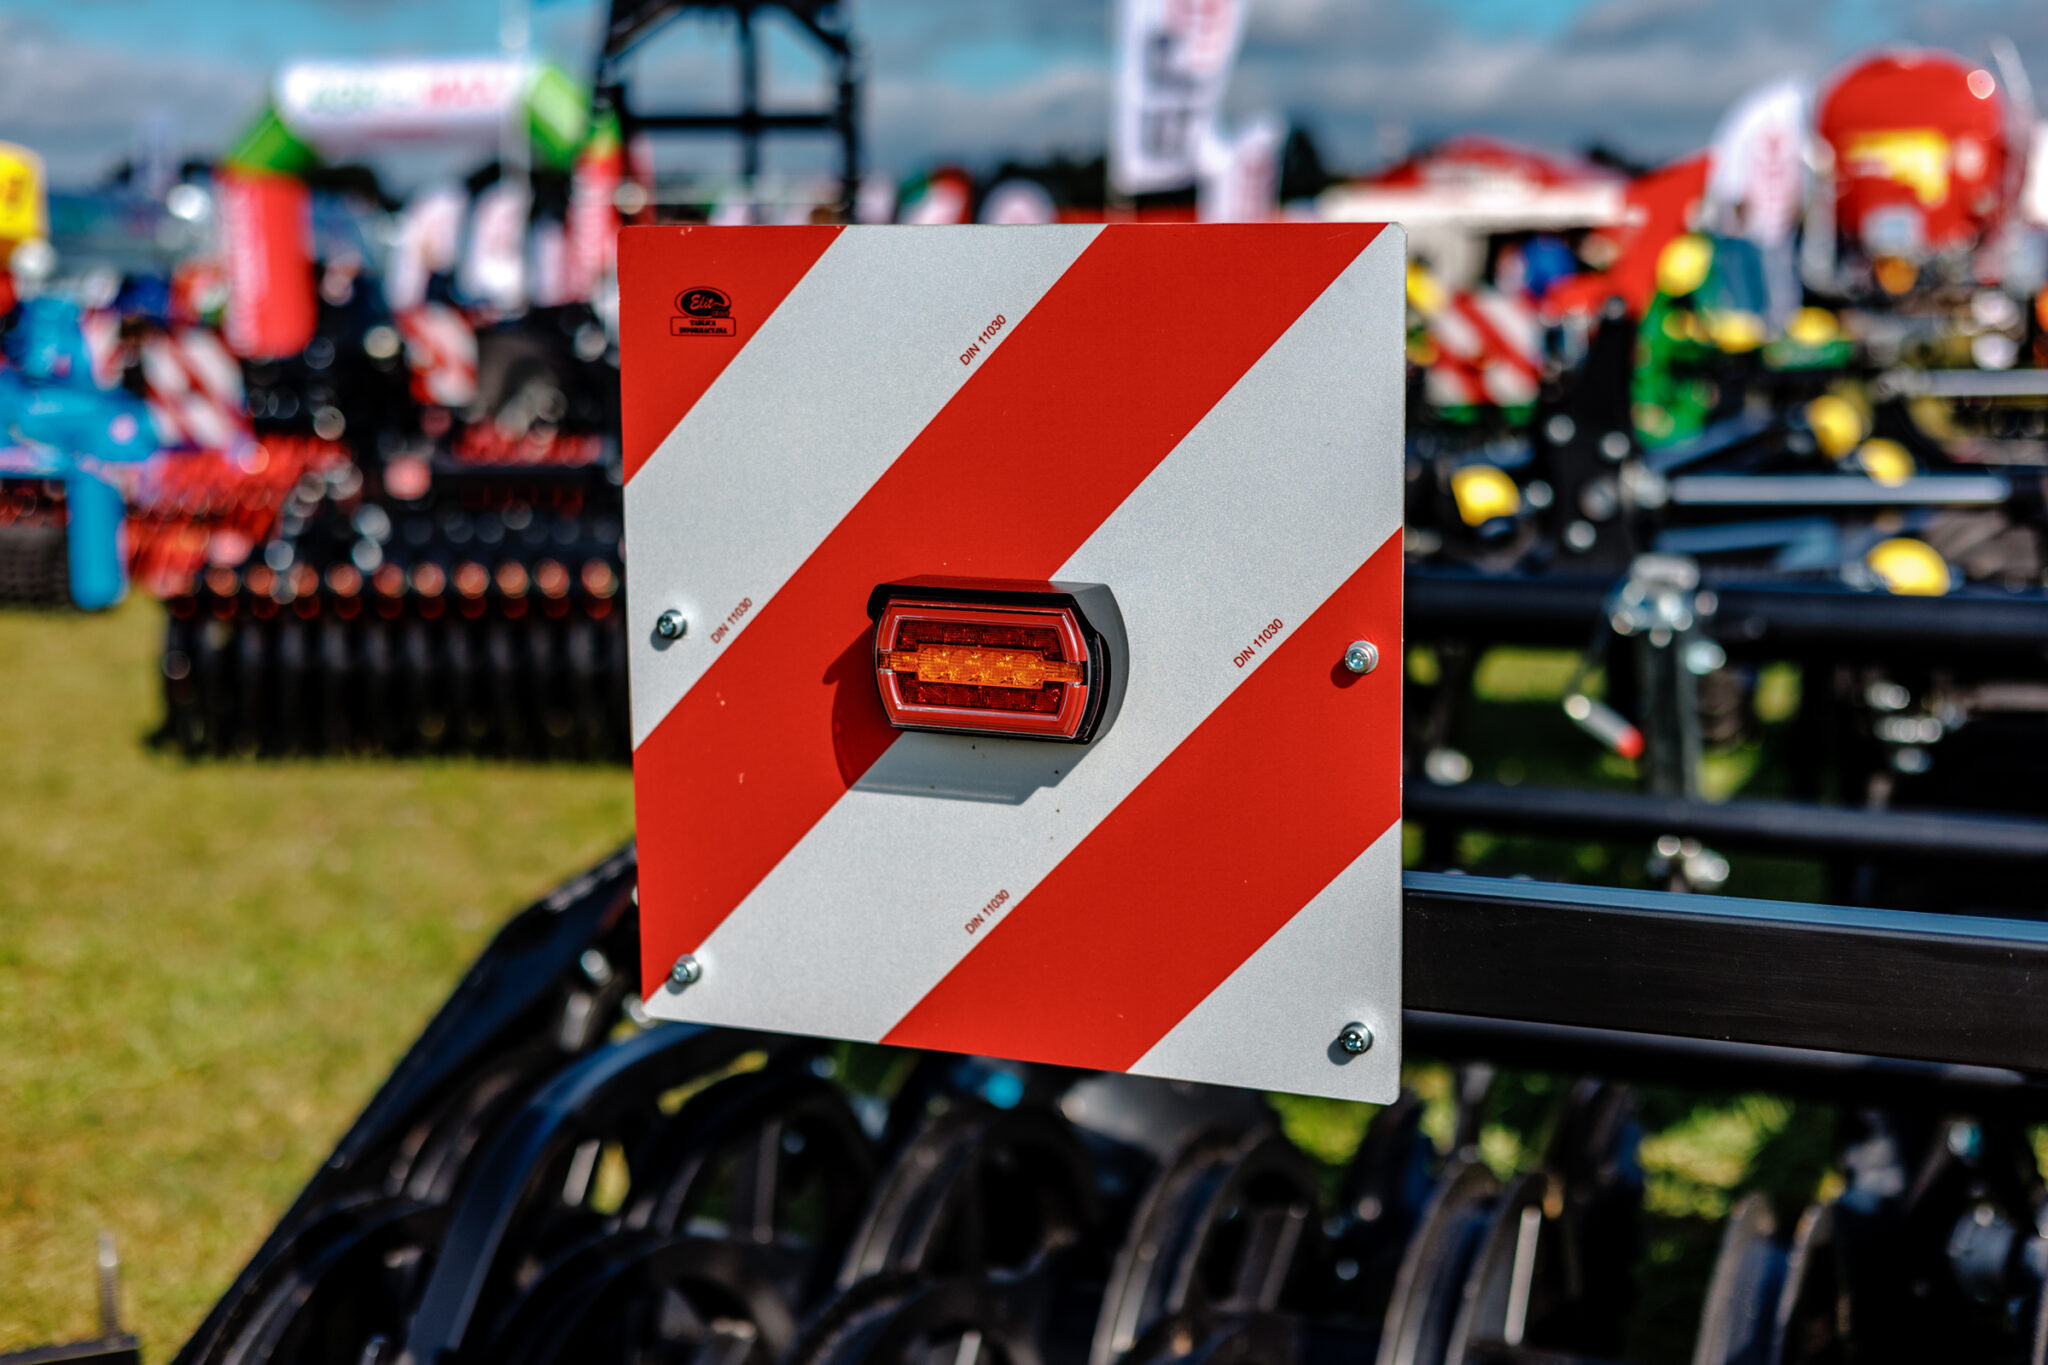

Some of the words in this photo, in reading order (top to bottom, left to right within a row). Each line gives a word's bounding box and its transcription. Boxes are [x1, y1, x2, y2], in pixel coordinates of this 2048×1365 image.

[689, 294, 714, 310] Elit
[960, 343, 980, 366] DIN
[978, 314, 1006, 345] 11030
[711, 622, 729, 644] DIN
[727, 597, 752, 625] 11030
[1233, 645, 1256, 668] DIN
[1253, 618, 1283, 648] 11030
[965, 913, 985, 935] DIN
[982, 889, 1010, 916] 11030
